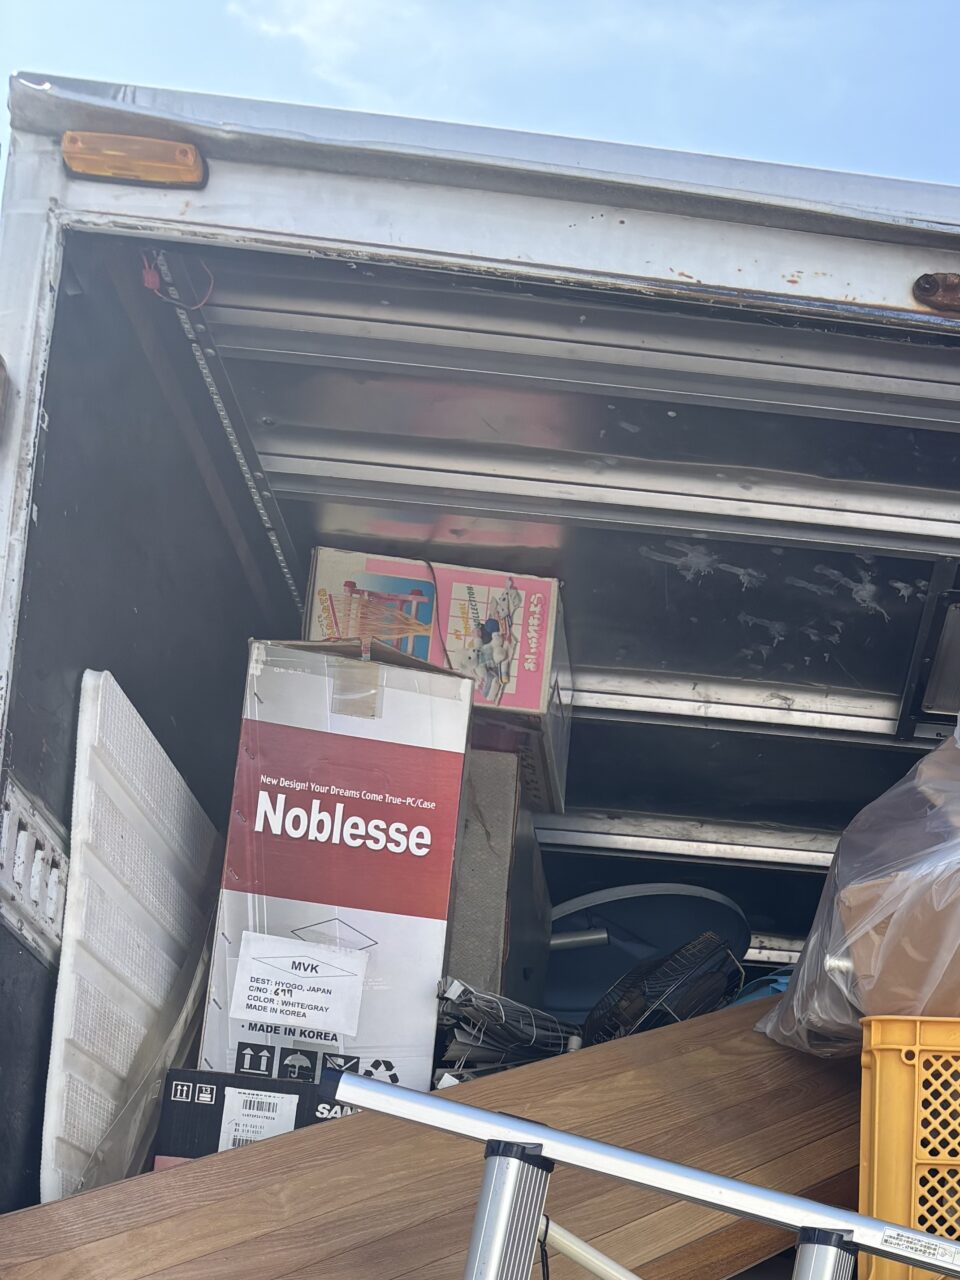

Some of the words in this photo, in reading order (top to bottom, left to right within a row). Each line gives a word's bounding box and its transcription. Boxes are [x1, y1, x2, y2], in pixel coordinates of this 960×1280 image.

[260, 774, 278, 785] New
[279, 778, 308, 790] Design!
[310, 783, 329, 793] Your
[330, 786, 360, 798] Dreams
[361, 791, 383, 801] Come
[254, 790, 432, 857] Noblesse
[291, 961, 320, 974] MVK
[248, 985, 268, 994] C/NO
[250, 976, 272, 986] DEST:
[274, 980, 305, 992] HYOGO,
[306, 986, 332, 995] JAPAN
[245, 1003, 268, 1012] MADE
[270, 1006, 278, 1014] IN
[279, 1008, 307, 1018] KOREA
[247, 994, 275, 1004] COLOR
[281, 1000, 330, 1013] WHITE/GRAY
[248, 1022, 281, 1035] MADE
[283, 1027, 296, 1037] IN
[299, 1029, 339, 1042] KOREA
[315, 1103, 363, 1119] SAN
